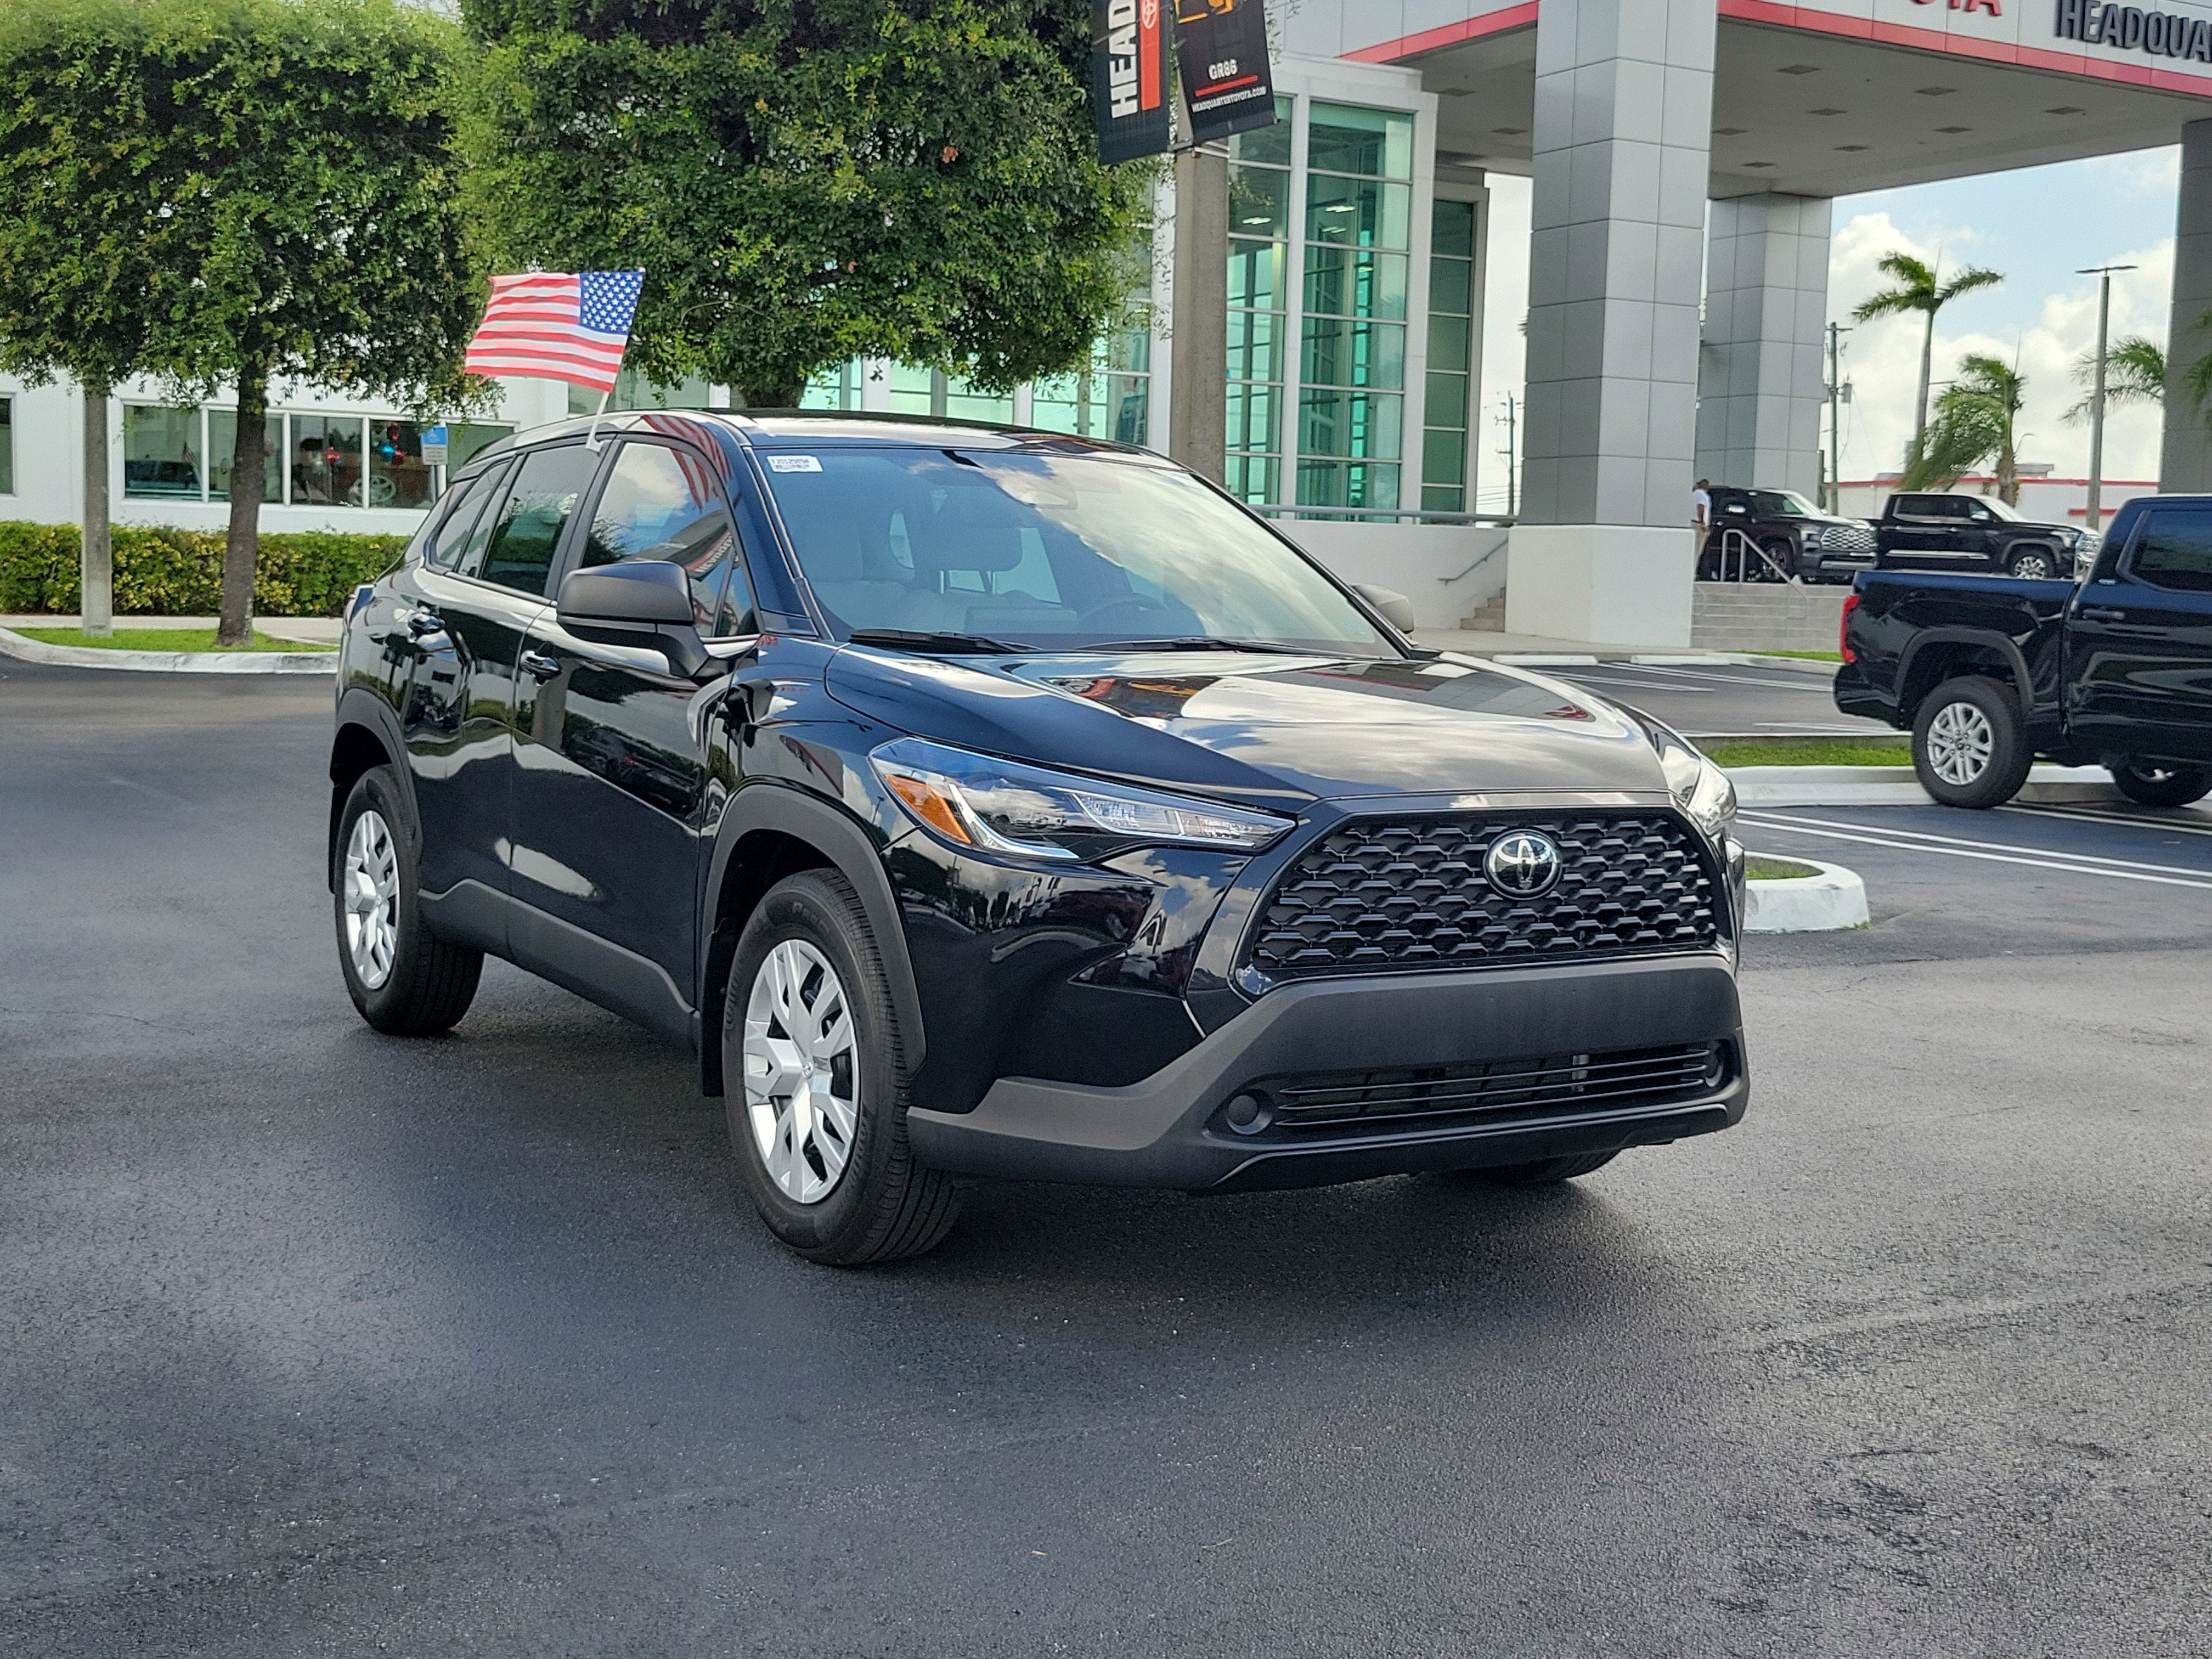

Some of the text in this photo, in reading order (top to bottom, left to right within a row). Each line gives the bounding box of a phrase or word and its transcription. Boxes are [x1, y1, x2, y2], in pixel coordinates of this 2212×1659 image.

[1108, 0, 1138, 119] HEAD
[2055, 0, 2212, 63] HEADQUA
[1209, 59, 1238, 80] GR86
